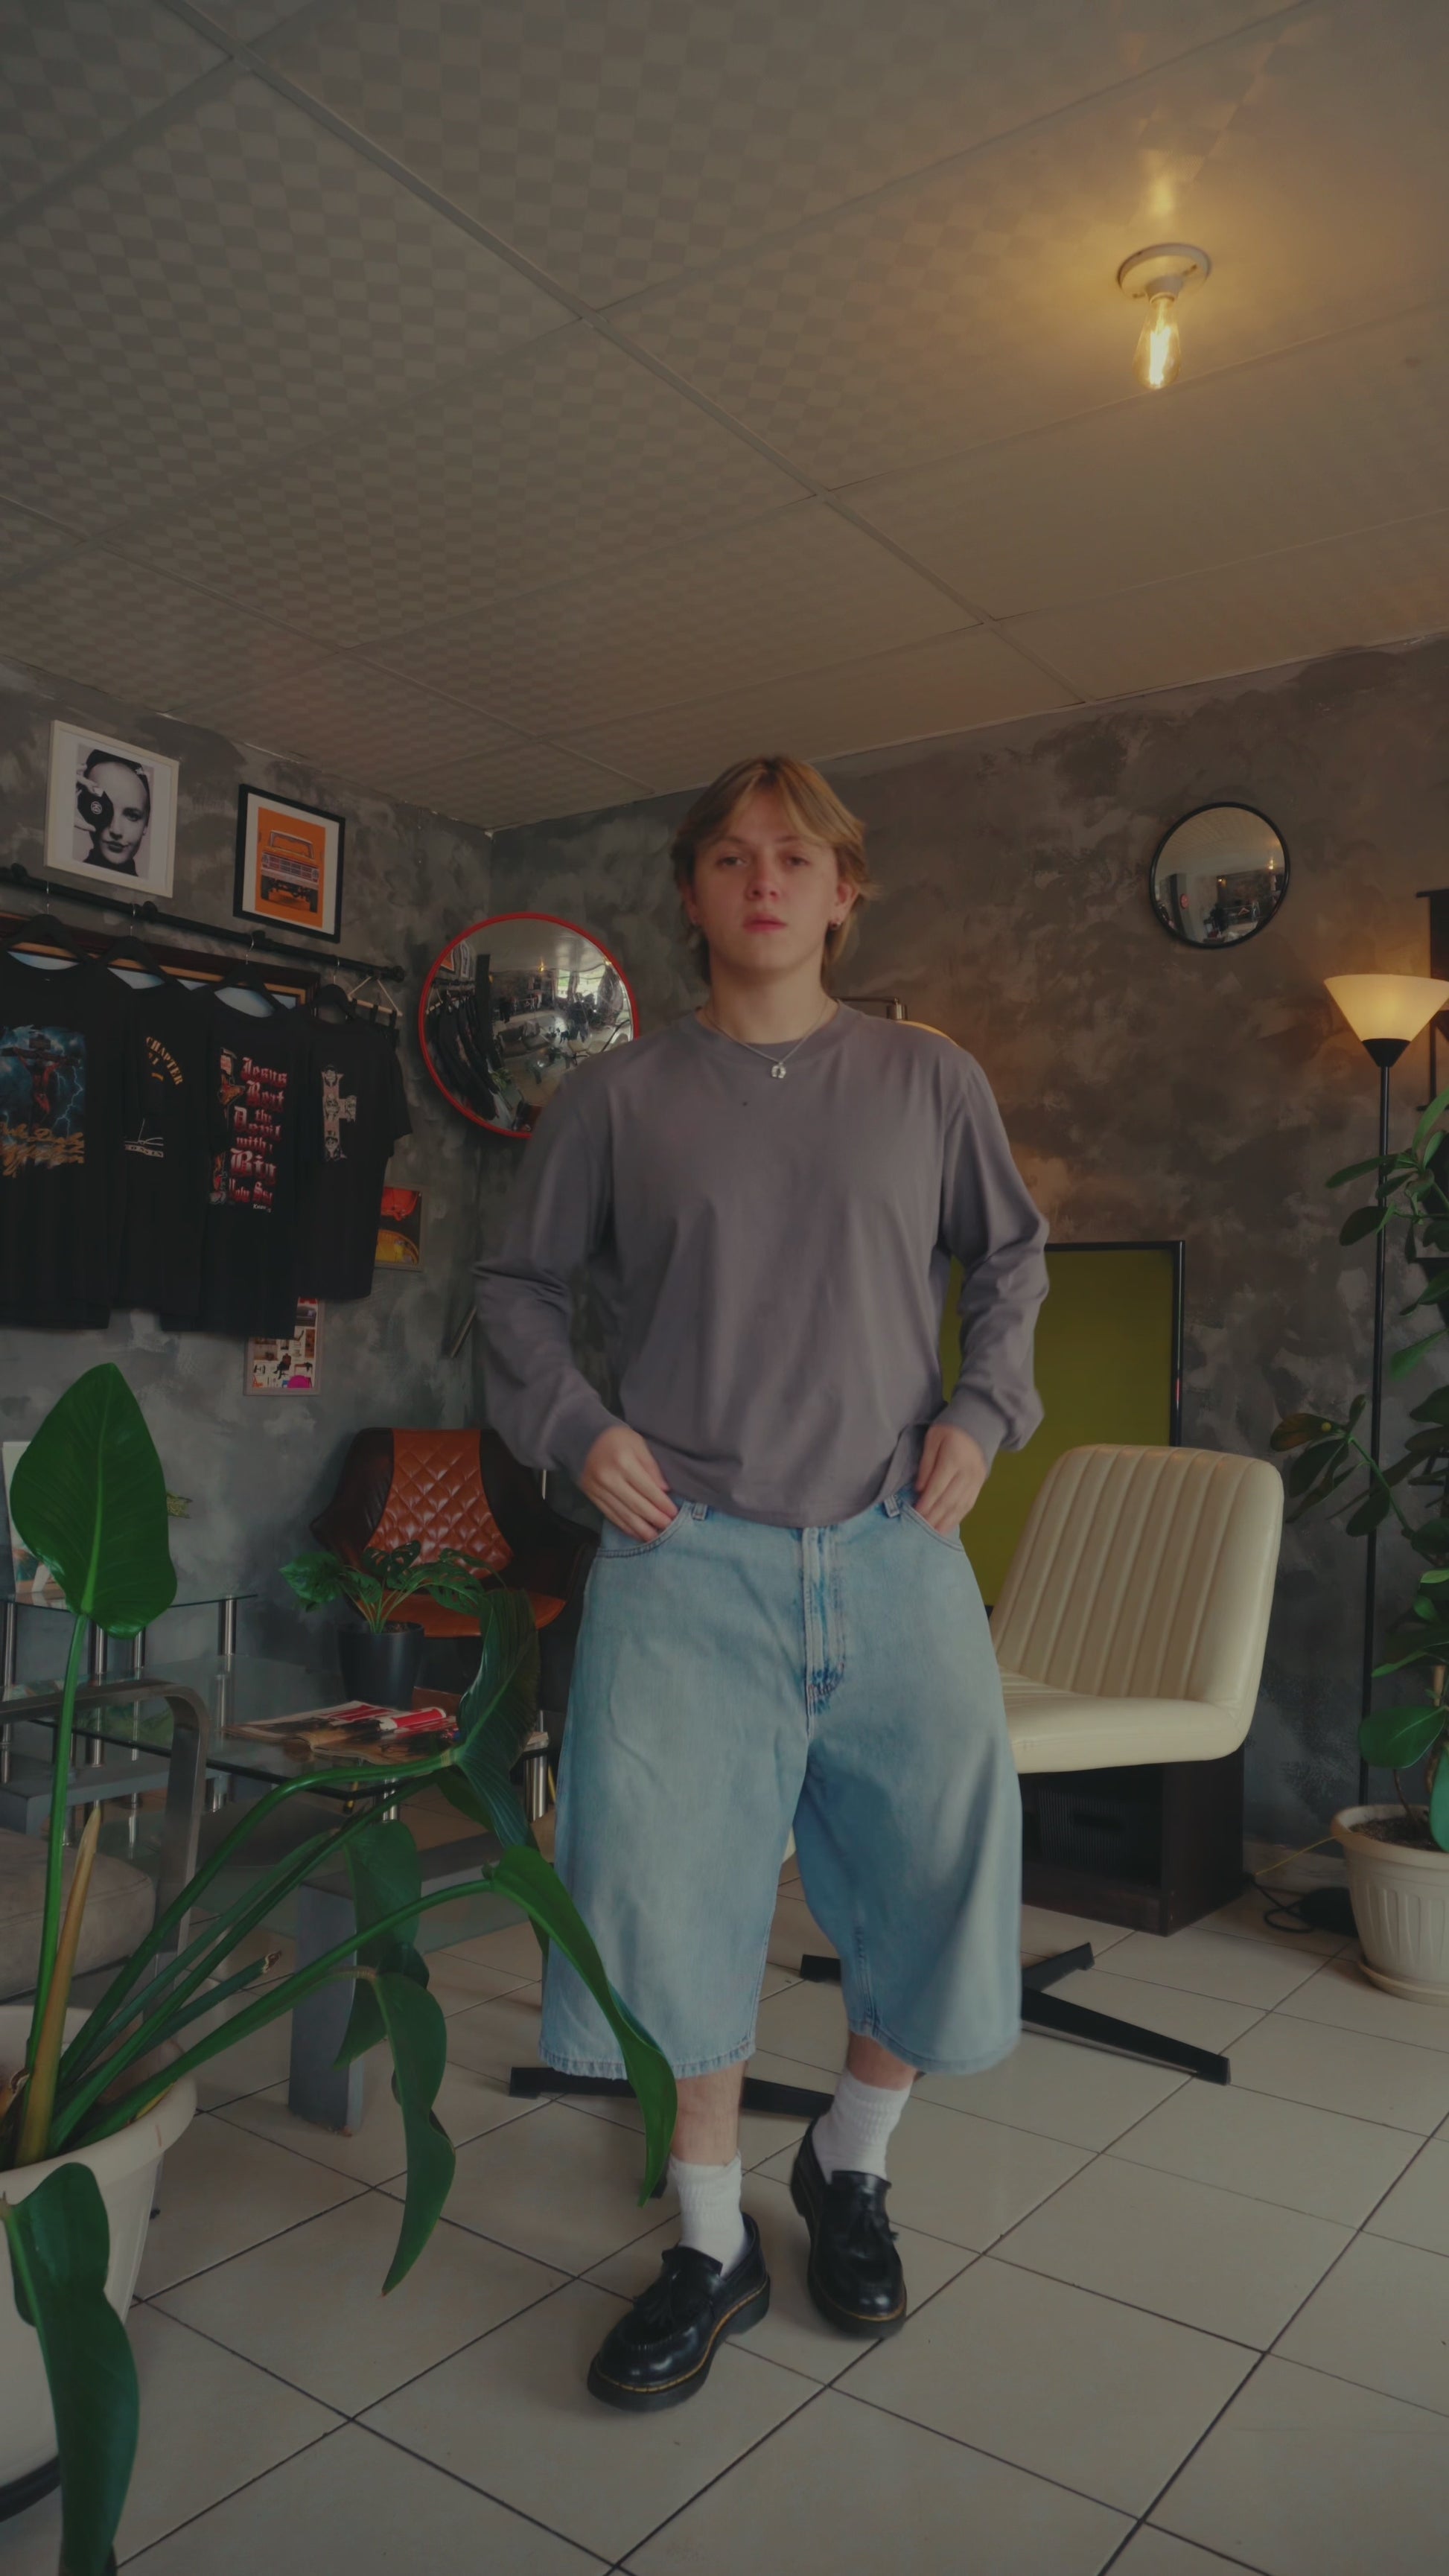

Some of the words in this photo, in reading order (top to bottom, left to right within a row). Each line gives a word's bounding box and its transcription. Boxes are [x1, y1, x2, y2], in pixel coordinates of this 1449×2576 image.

[145, 1036, 183, 1085] CHAPTER
[241, 1056, 288, 1087] Jesus
[234, 1106, 281, 1141] Devil
[236, 1136, 267, 1155] with
[230, 1147, 277, 1187] Big
